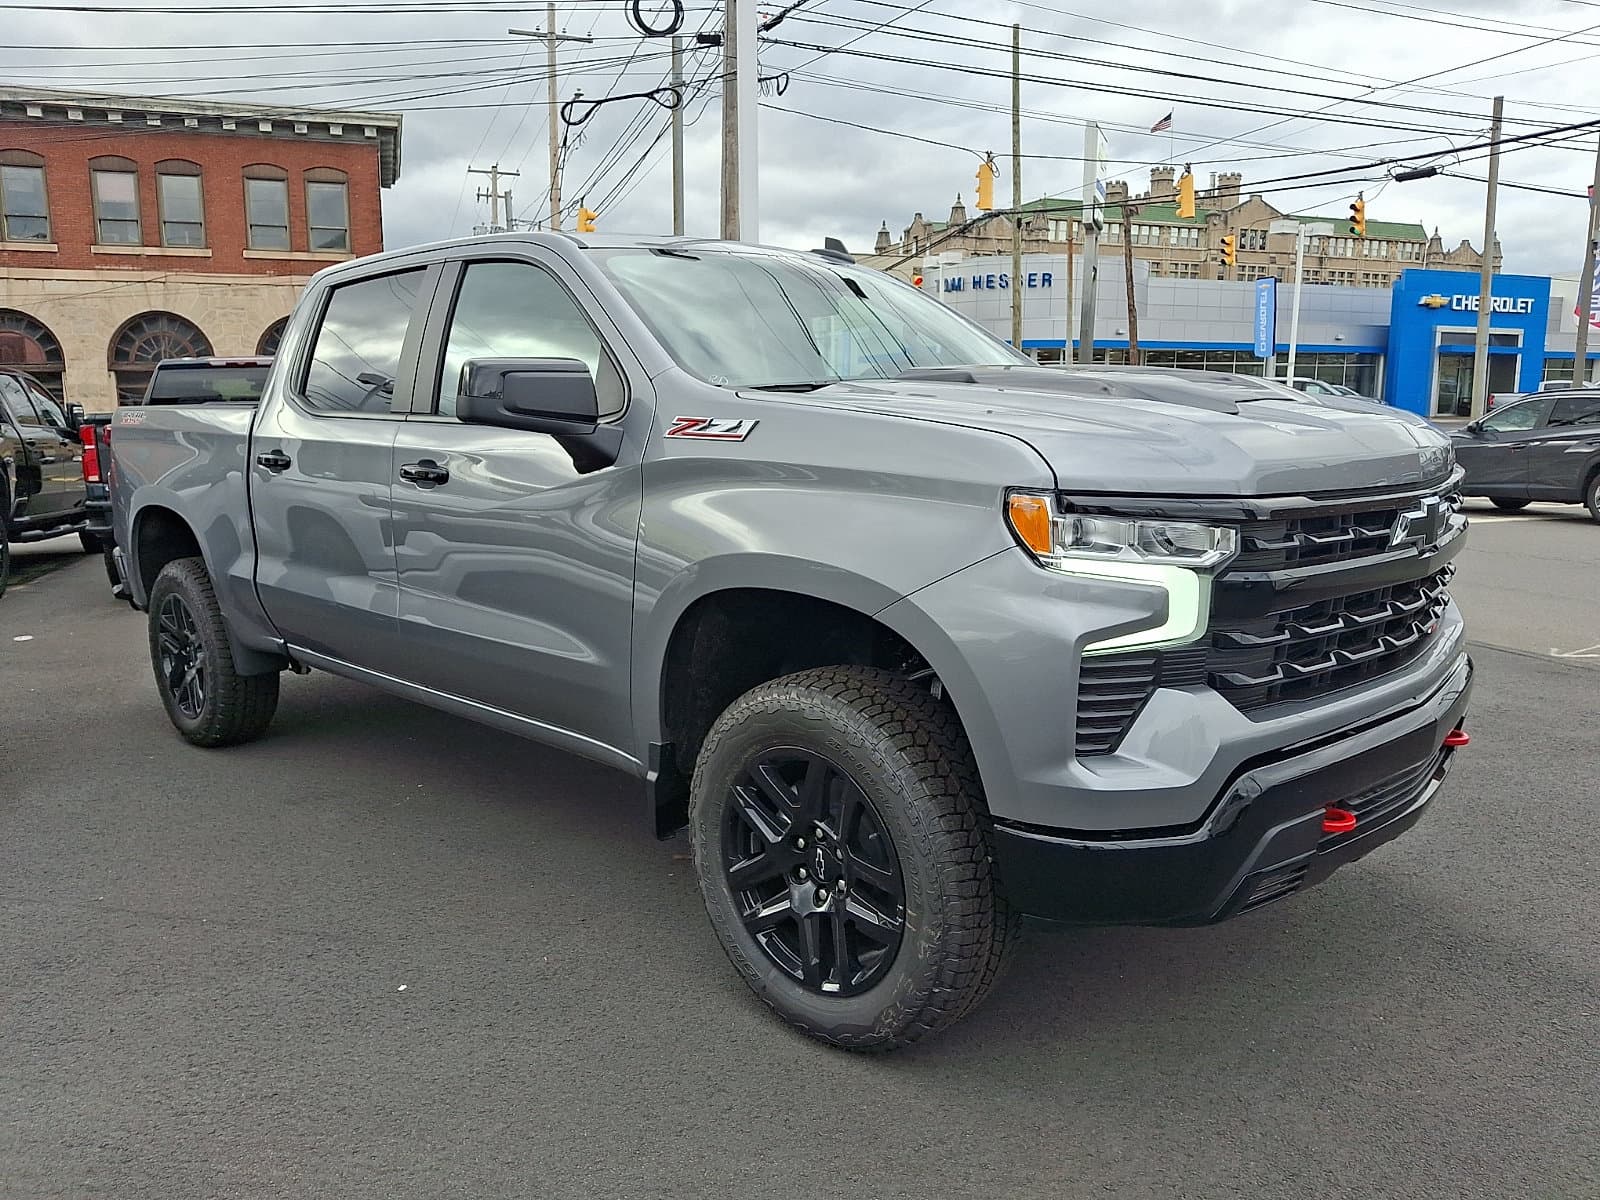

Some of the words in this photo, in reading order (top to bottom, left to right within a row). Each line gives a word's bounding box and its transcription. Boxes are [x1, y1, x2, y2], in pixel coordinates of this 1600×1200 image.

[972, 272, 1053, 289] HESER
[1451, 294, 1535, 314] CHEROLET
[664, 416, 760, 442] Z71
